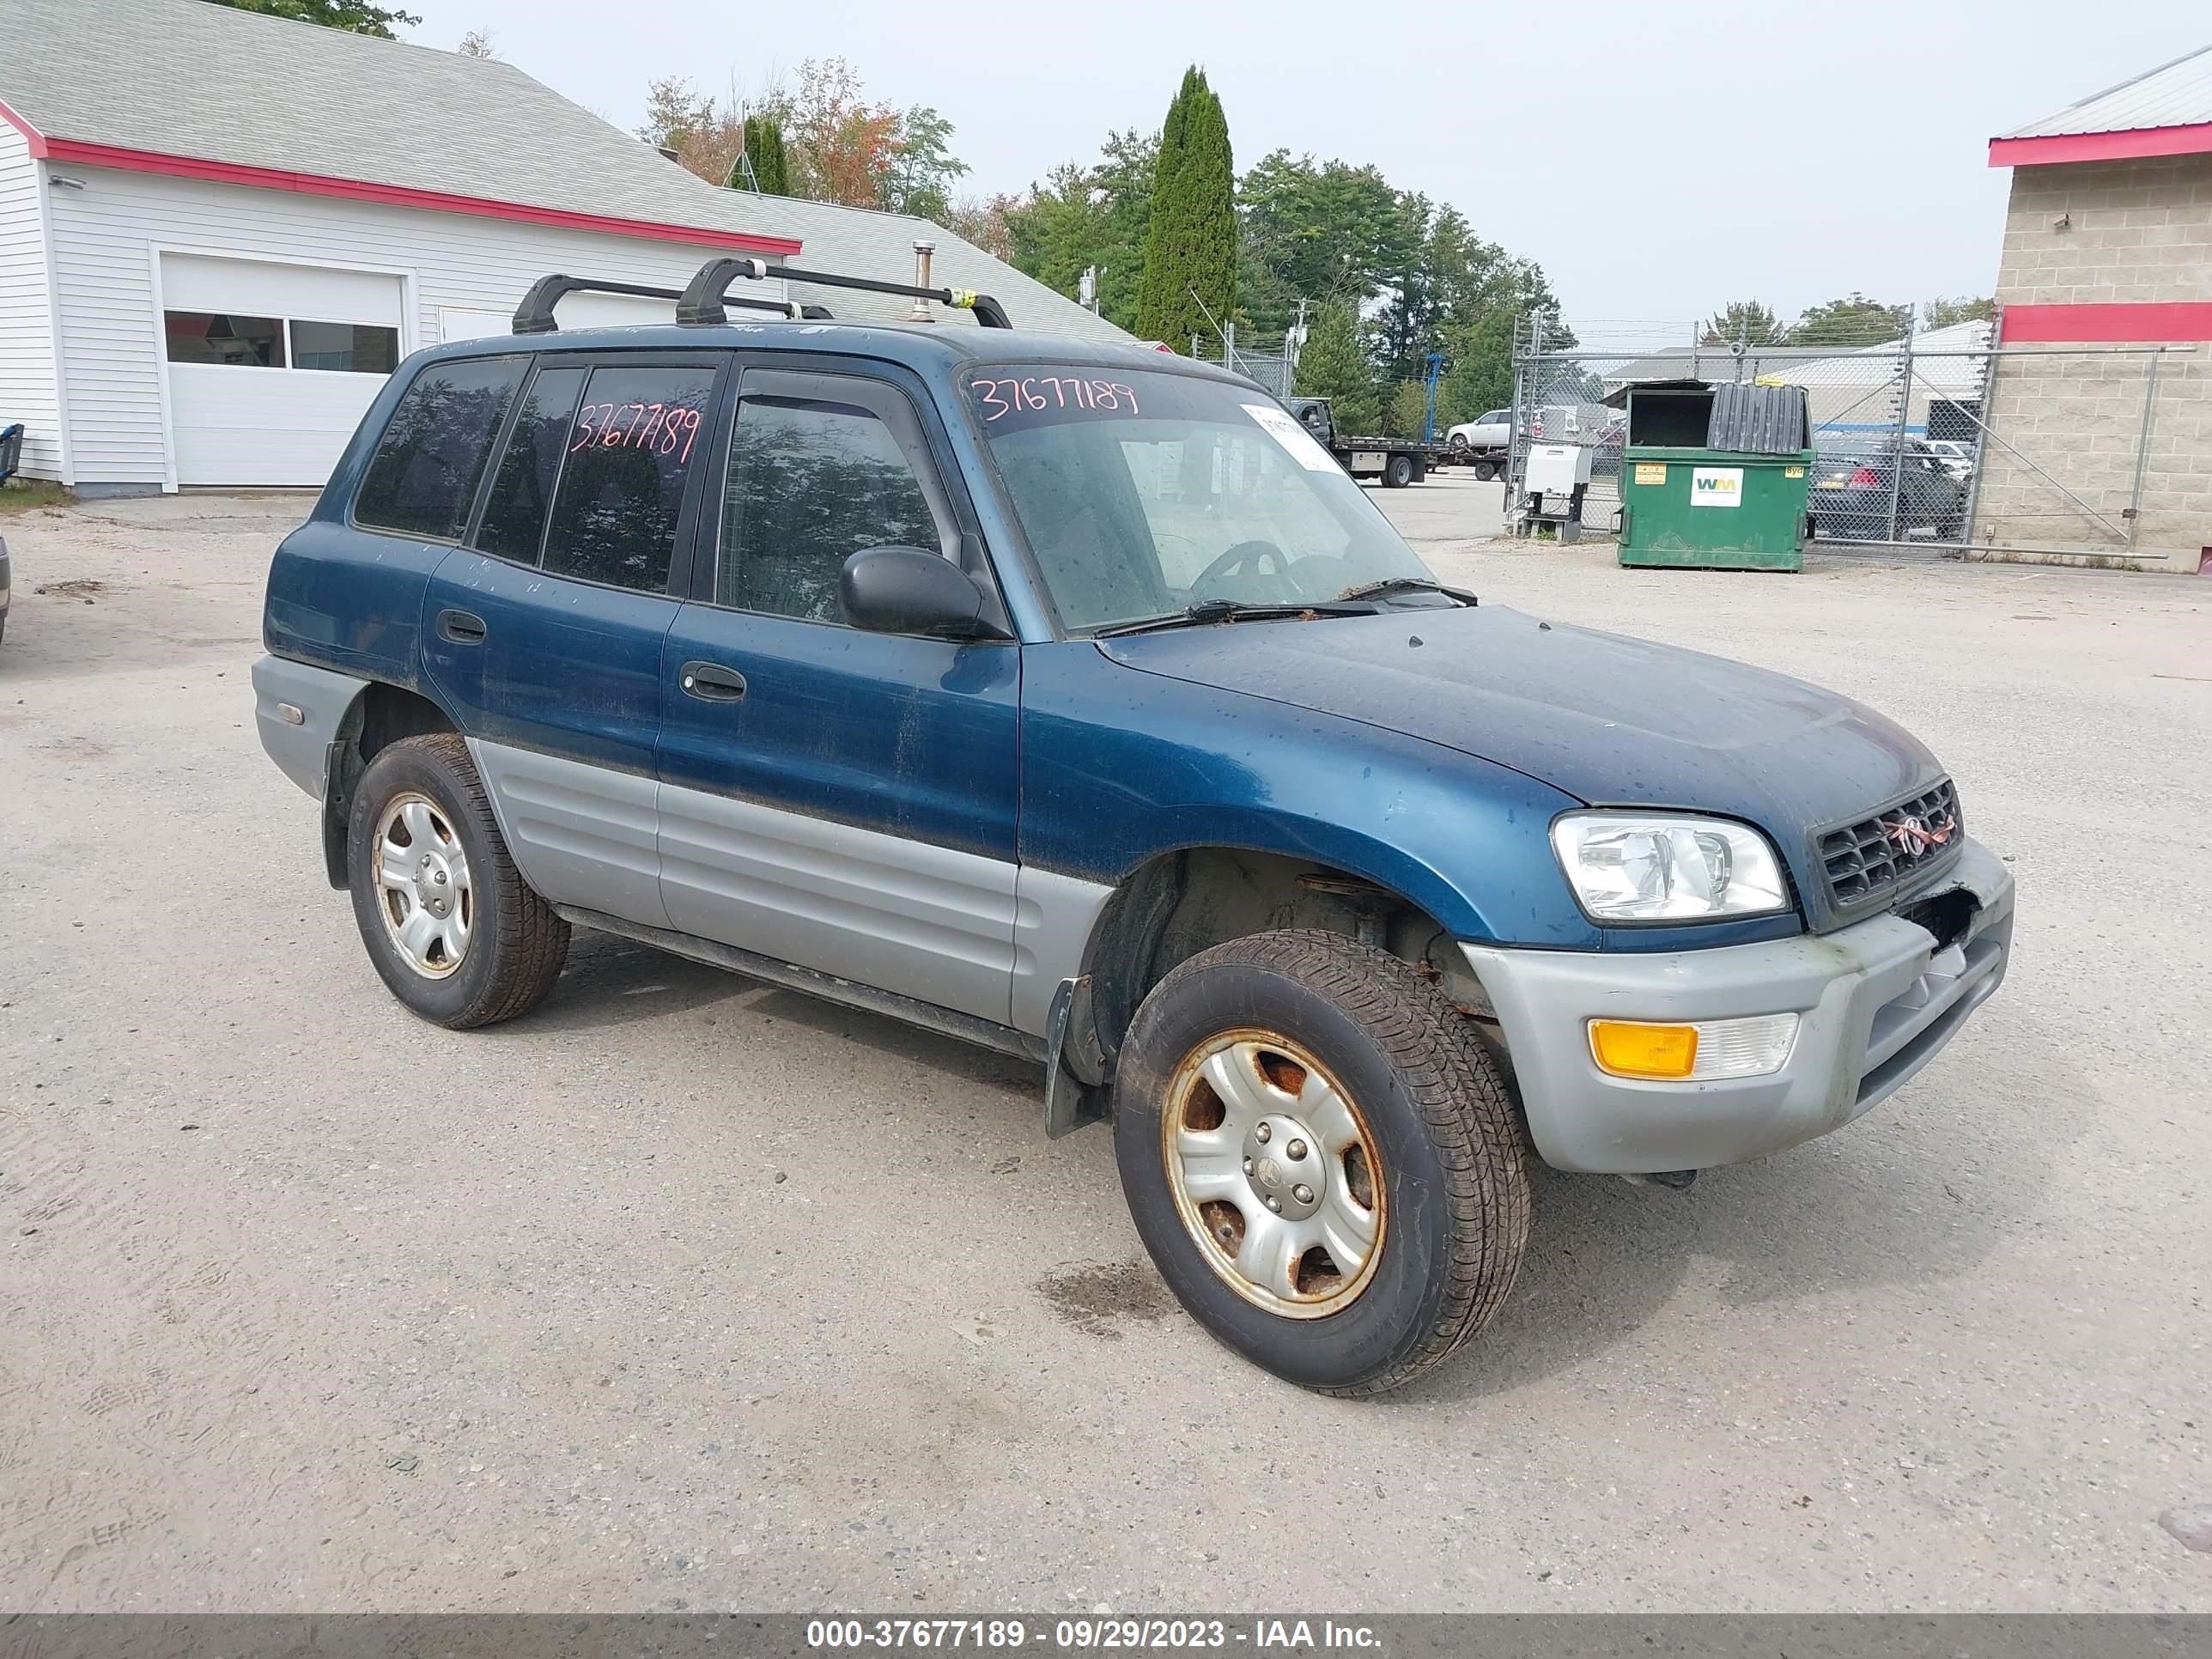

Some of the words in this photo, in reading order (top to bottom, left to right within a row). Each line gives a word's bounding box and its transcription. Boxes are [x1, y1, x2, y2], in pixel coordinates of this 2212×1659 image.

[971, 377, 1139, 421] 37677189
[570, 403, 701, 464] 37677189
[1696, 477, 1737, 491] WM
[1786, 465, 1803, 476] 8yd
